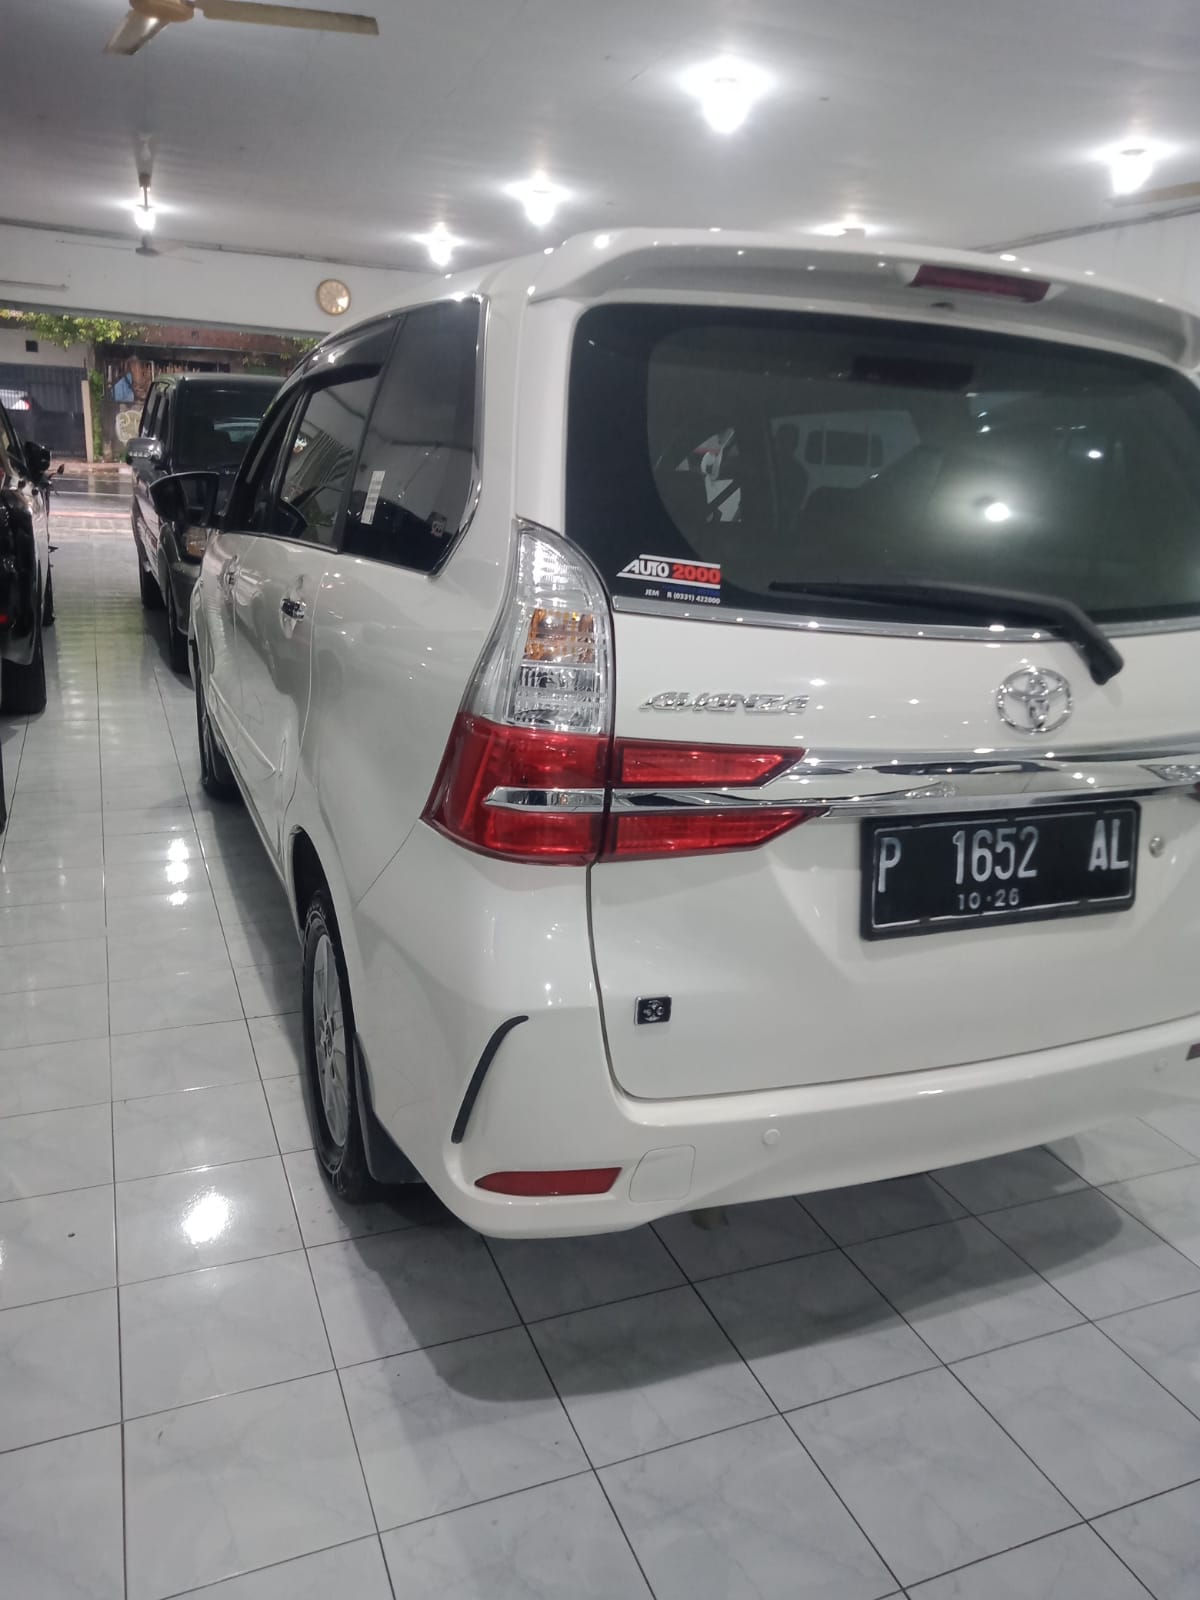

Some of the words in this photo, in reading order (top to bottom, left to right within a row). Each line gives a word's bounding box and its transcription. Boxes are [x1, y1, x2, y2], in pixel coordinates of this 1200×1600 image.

[622, 559, 670, 578] AUTO
[671, 563, 722, 585] 2000
[878, 837, 902, 893] P
[952, 826, 1039, 885] 1652
[1088, 819, 1129, 872] AL
